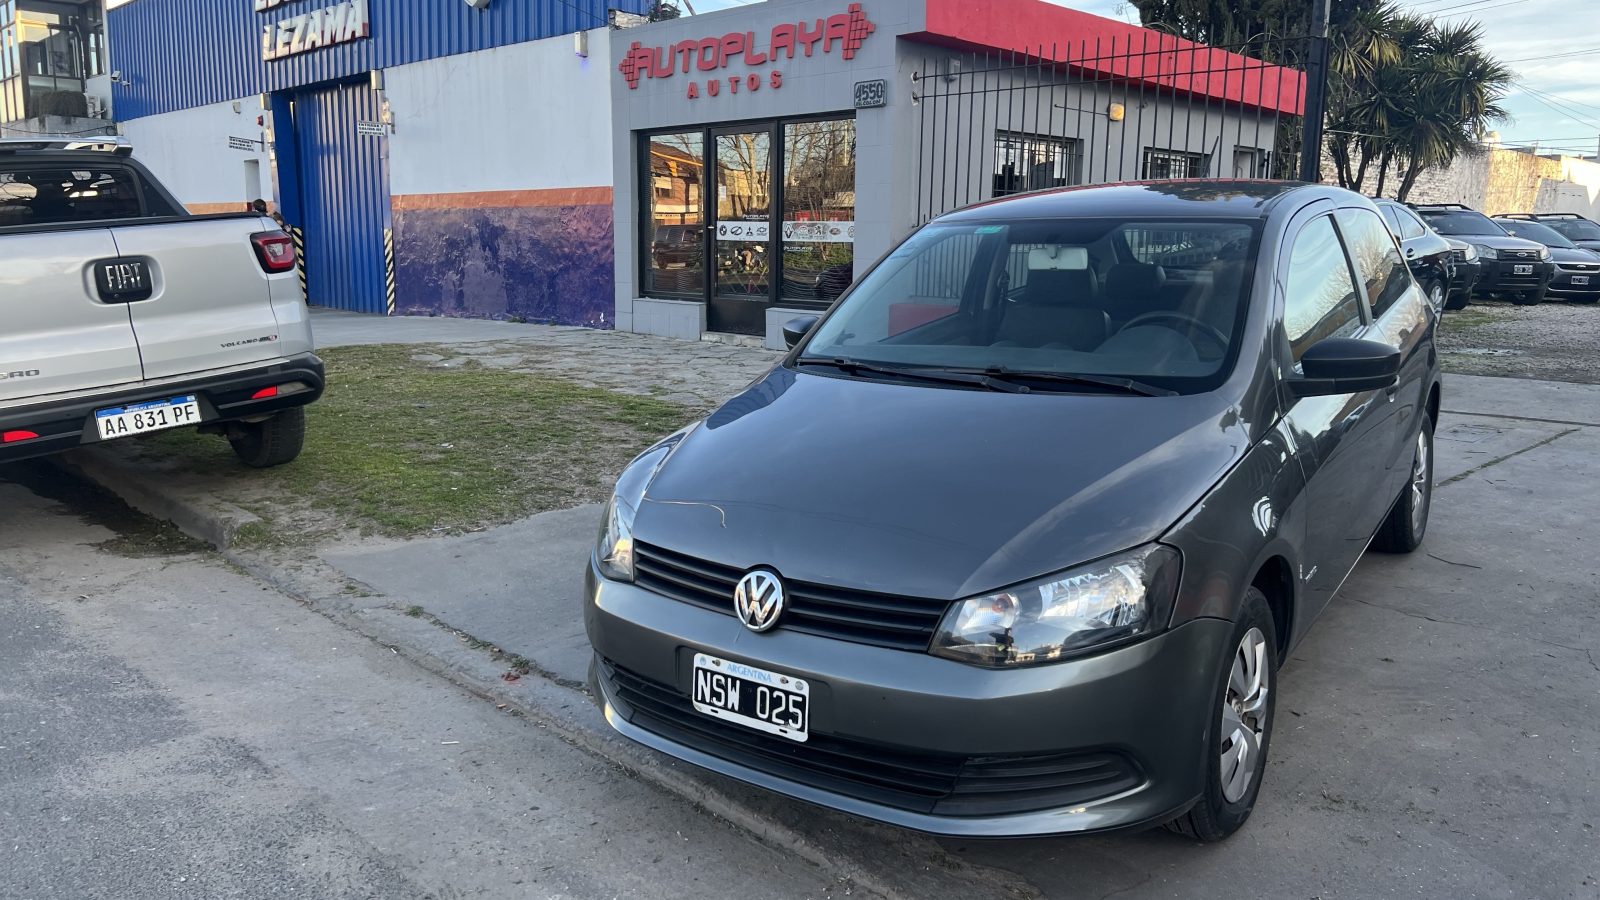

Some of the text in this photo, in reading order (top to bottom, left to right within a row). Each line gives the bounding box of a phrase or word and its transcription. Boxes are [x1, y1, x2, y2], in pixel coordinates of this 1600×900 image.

[262, 0, 369, 61] LEZAMA
[632, 13, 854, 80] AUTOPLAYA
[687, 70, 782, 99] AUTOS
[855, 82, 884, 101] 4550
[105, 263, 142, 289] FIAT
[105, 404, 194, 435] AA 831 PF
[727, 663, 772, 682] ARGENTINA
[697, 669, 803, 729] NSW 025
